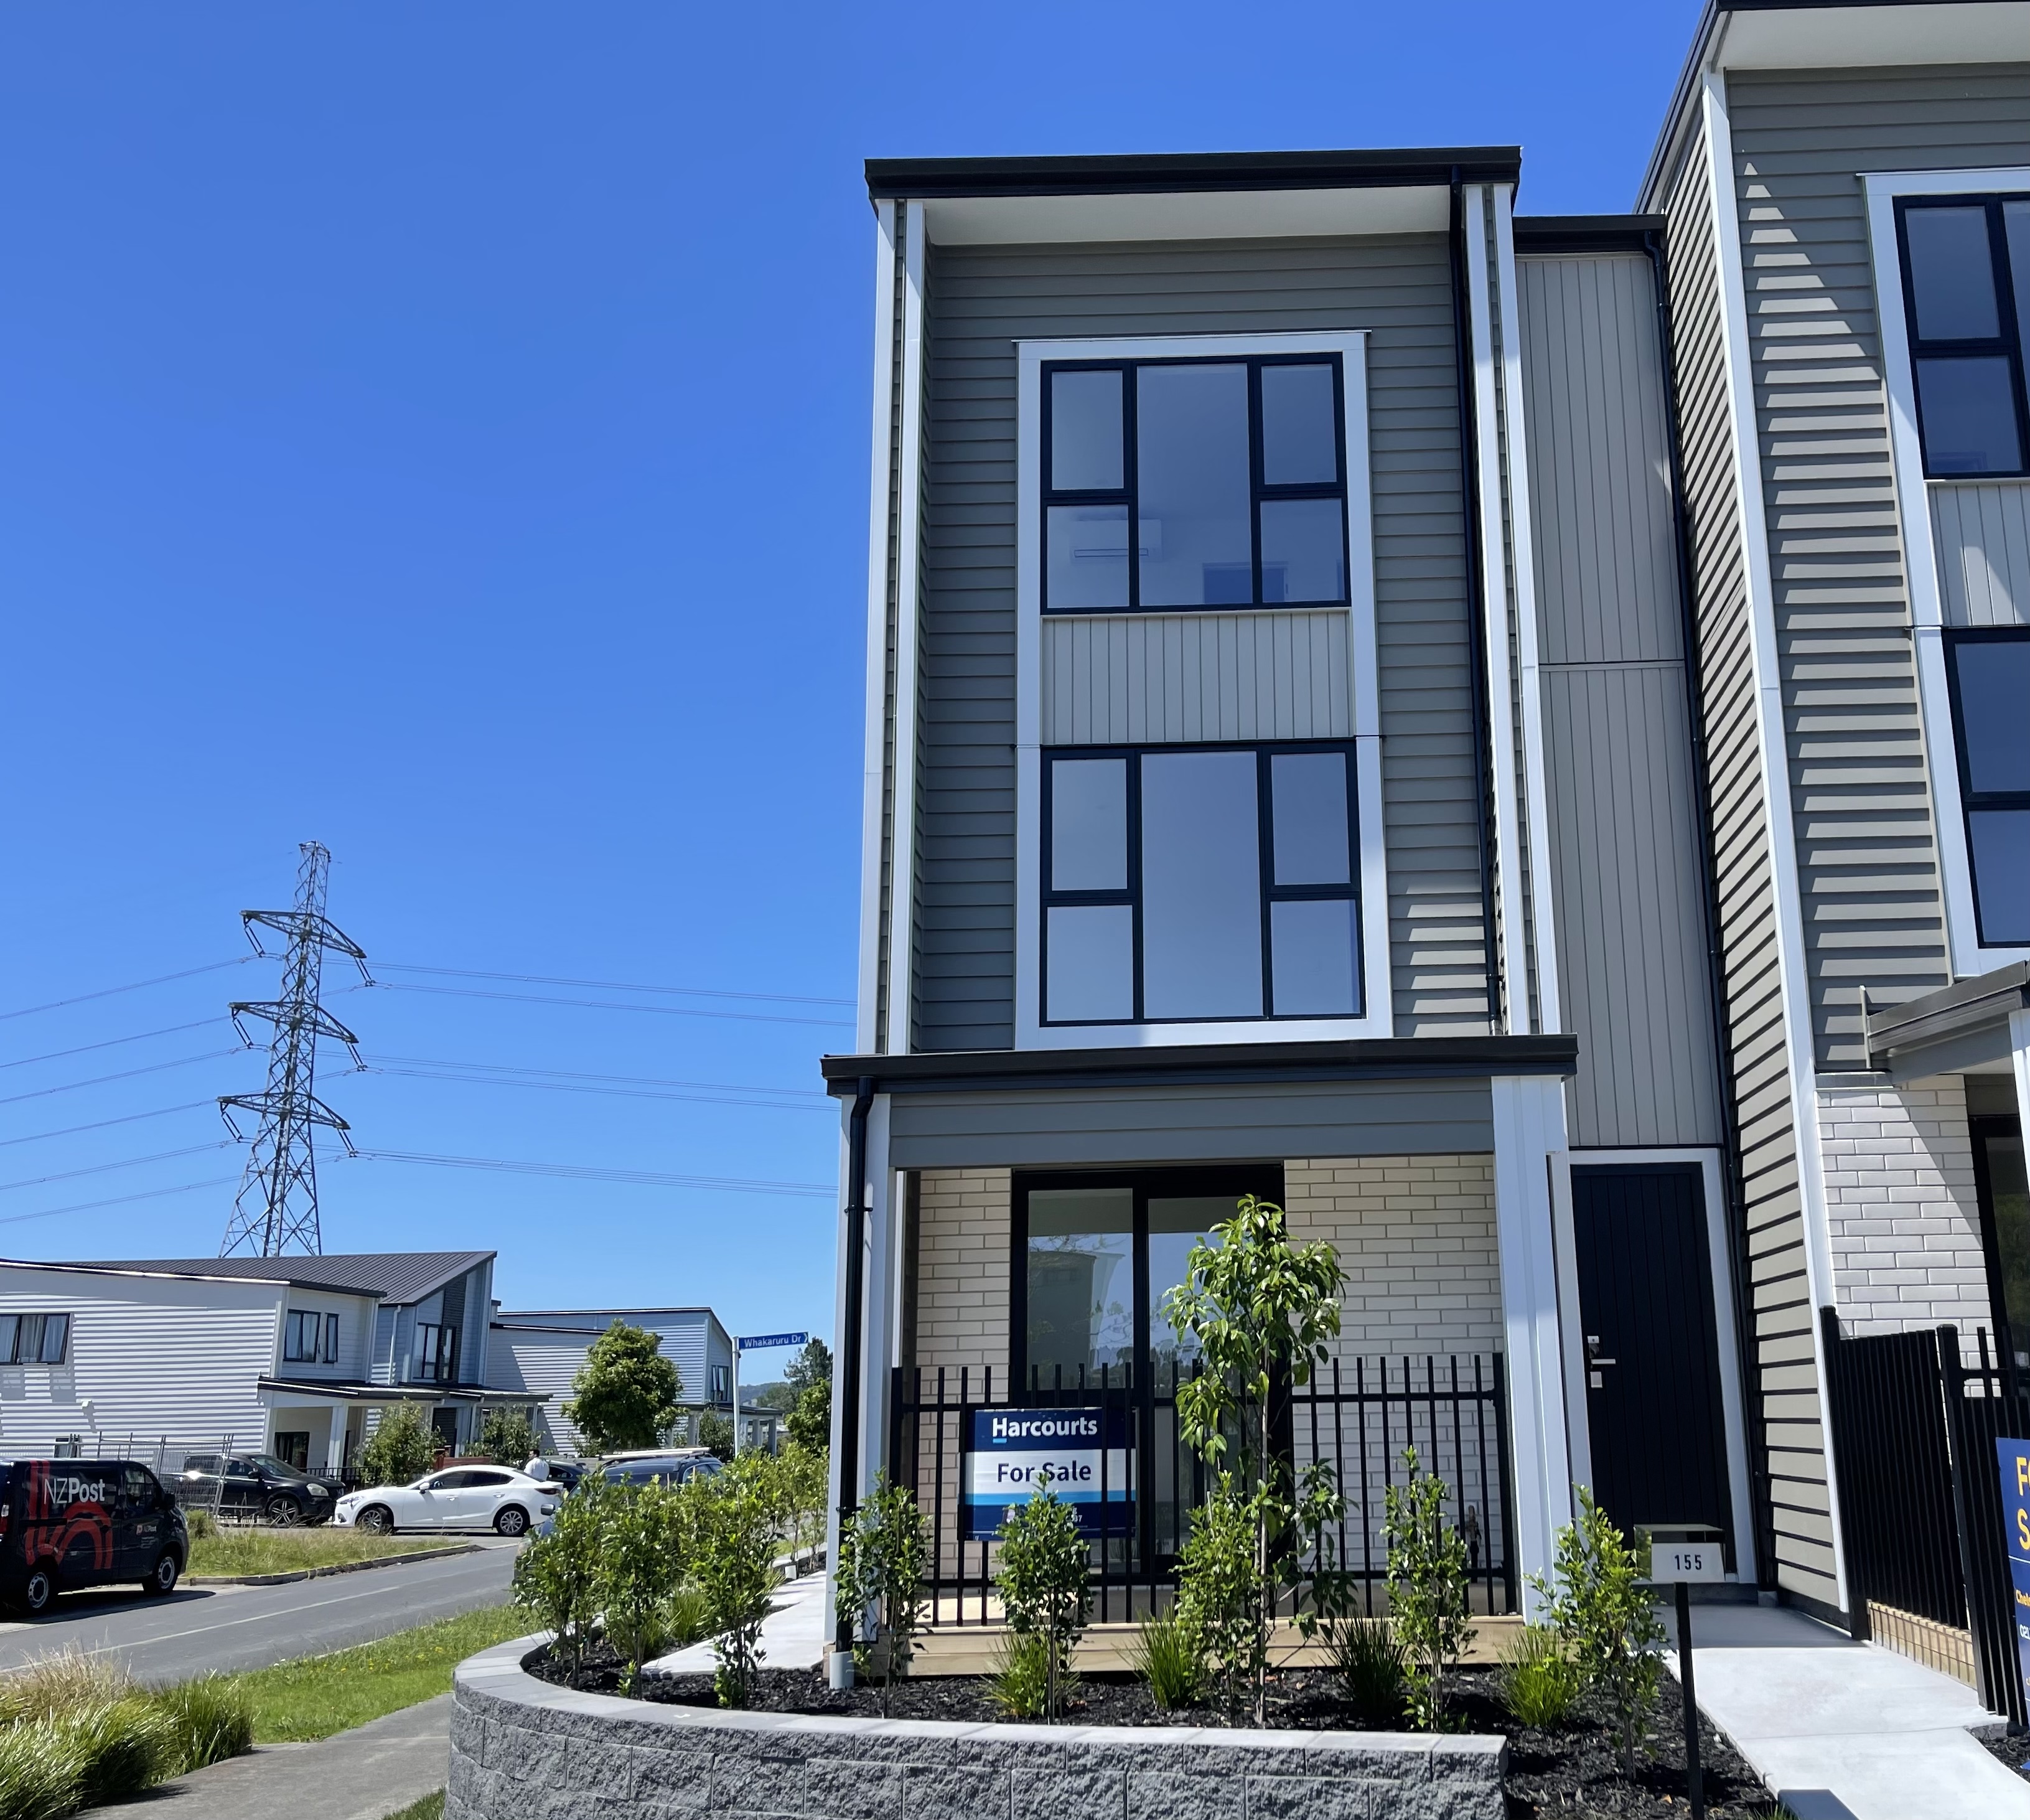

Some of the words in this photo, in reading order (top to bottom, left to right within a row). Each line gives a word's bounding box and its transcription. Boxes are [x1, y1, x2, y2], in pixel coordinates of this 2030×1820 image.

[744, 1337, 789, 1348] Whakaruru
[791, 1335, 802, 1343] Dr
[993, 1417, 1098, 1437] Harcourts
[998, 1463, 1035, 1483] For
[1042, 1460, 1092, 1482] Sale
[2016, 1456, 2030, 1496] F
[1674, 1554, 1702, 1570] 155
